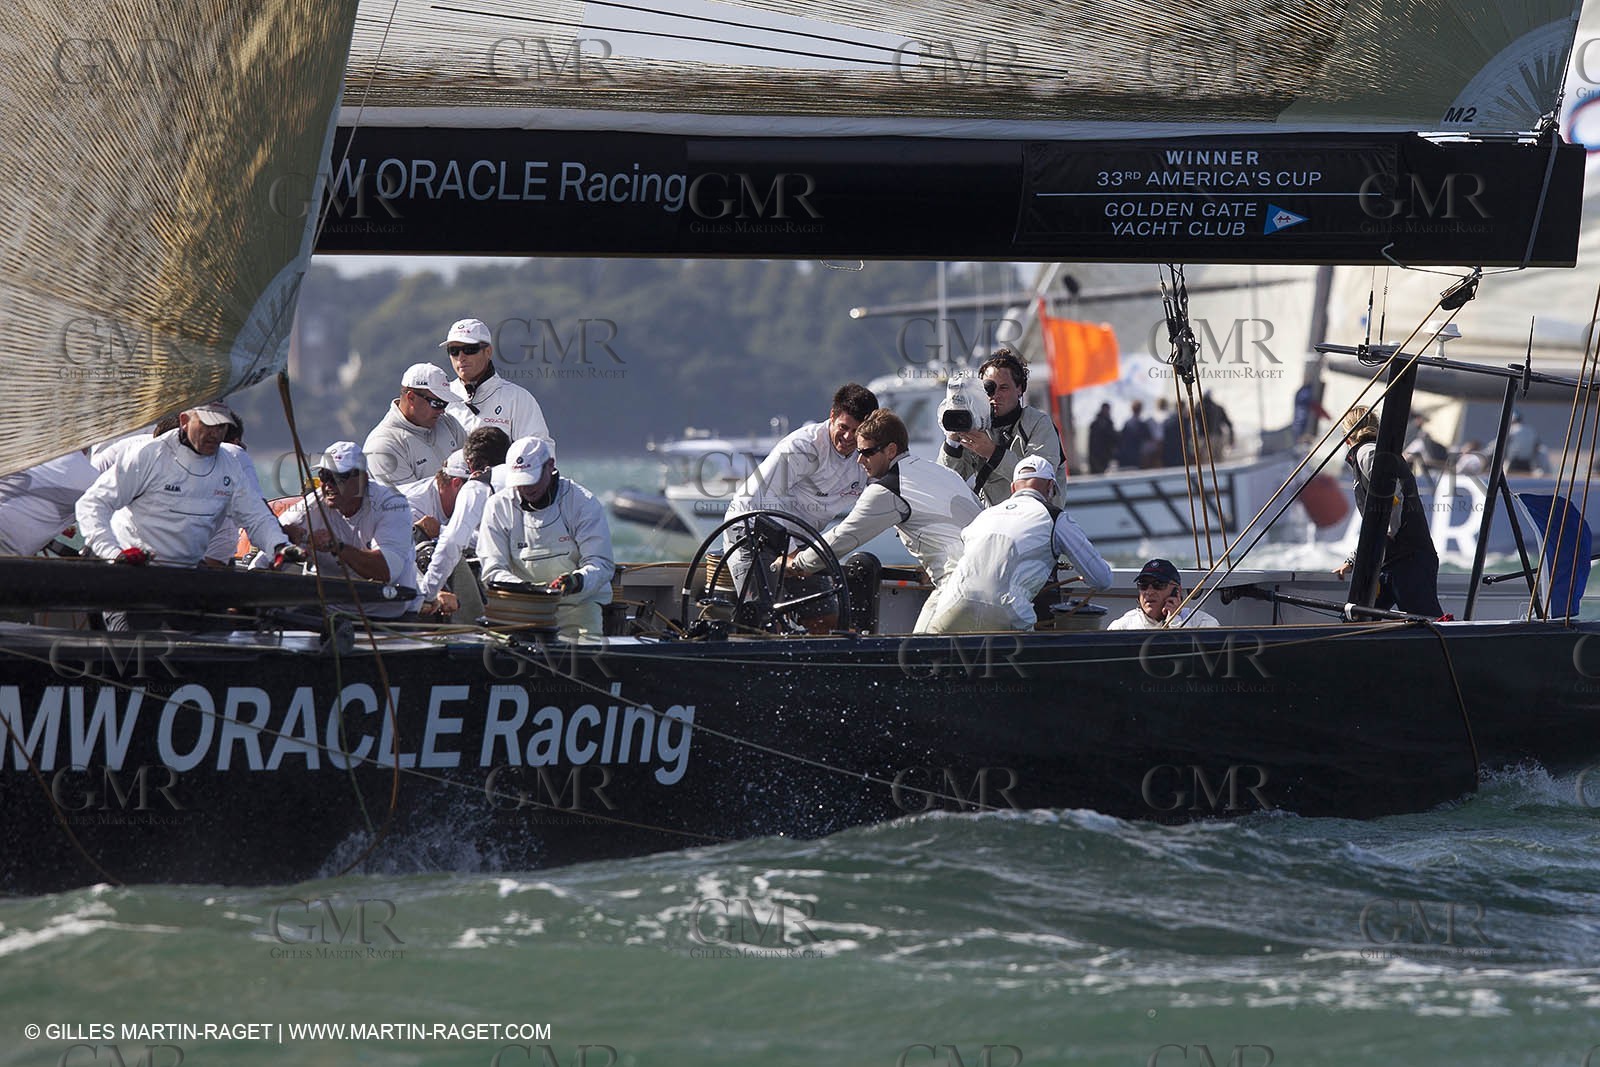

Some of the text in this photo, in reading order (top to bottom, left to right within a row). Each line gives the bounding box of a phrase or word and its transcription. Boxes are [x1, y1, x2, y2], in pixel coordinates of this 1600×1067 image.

[1444, 107, 1477, 122] M2
[1166, 151, 1259, 165] WINNER
[376, 158, 549, 201] ORACLE
[559, 162, 687, 213] Racing
[1097, 171, 1322, 186] 33RD AMERICA'S CUP
[1104, 203, 1257, 217] GOLDEN GATE
[1111, 221, 1245, 236] YACHT CLUB
[157, 683, 470, 772] ORACLE
[479, 681, 696, 785] Racing
